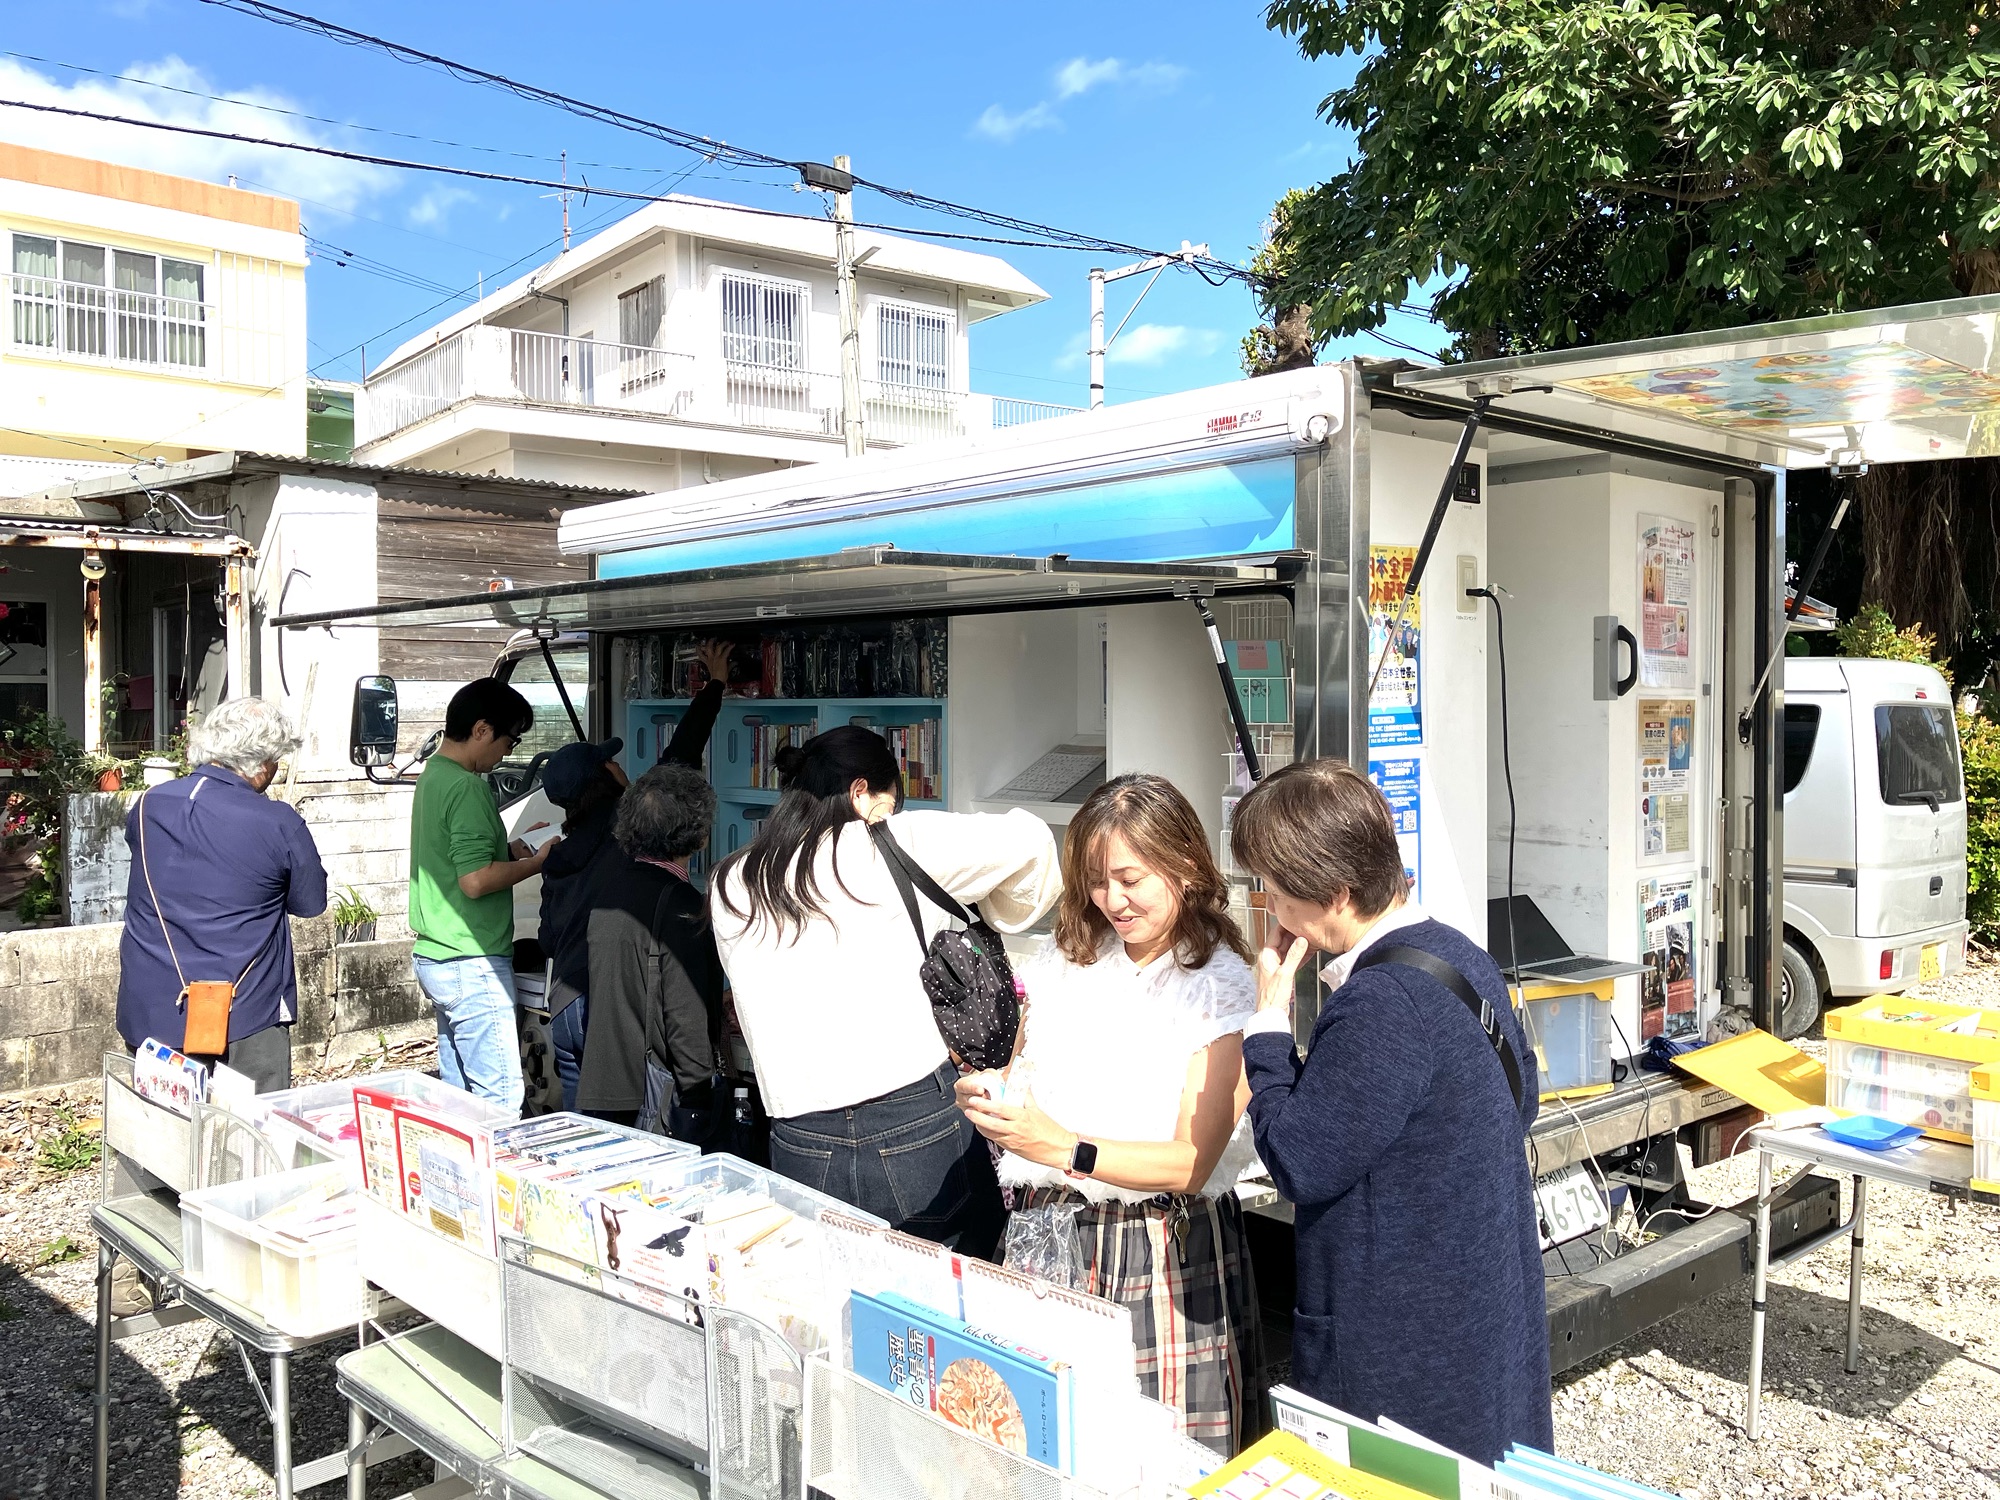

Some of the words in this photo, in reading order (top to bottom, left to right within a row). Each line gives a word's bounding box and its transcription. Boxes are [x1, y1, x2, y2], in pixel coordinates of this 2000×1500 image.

[887, 1330, 907, 1387] 歴史
[907, 1326, 927, 1407] 聖書の
